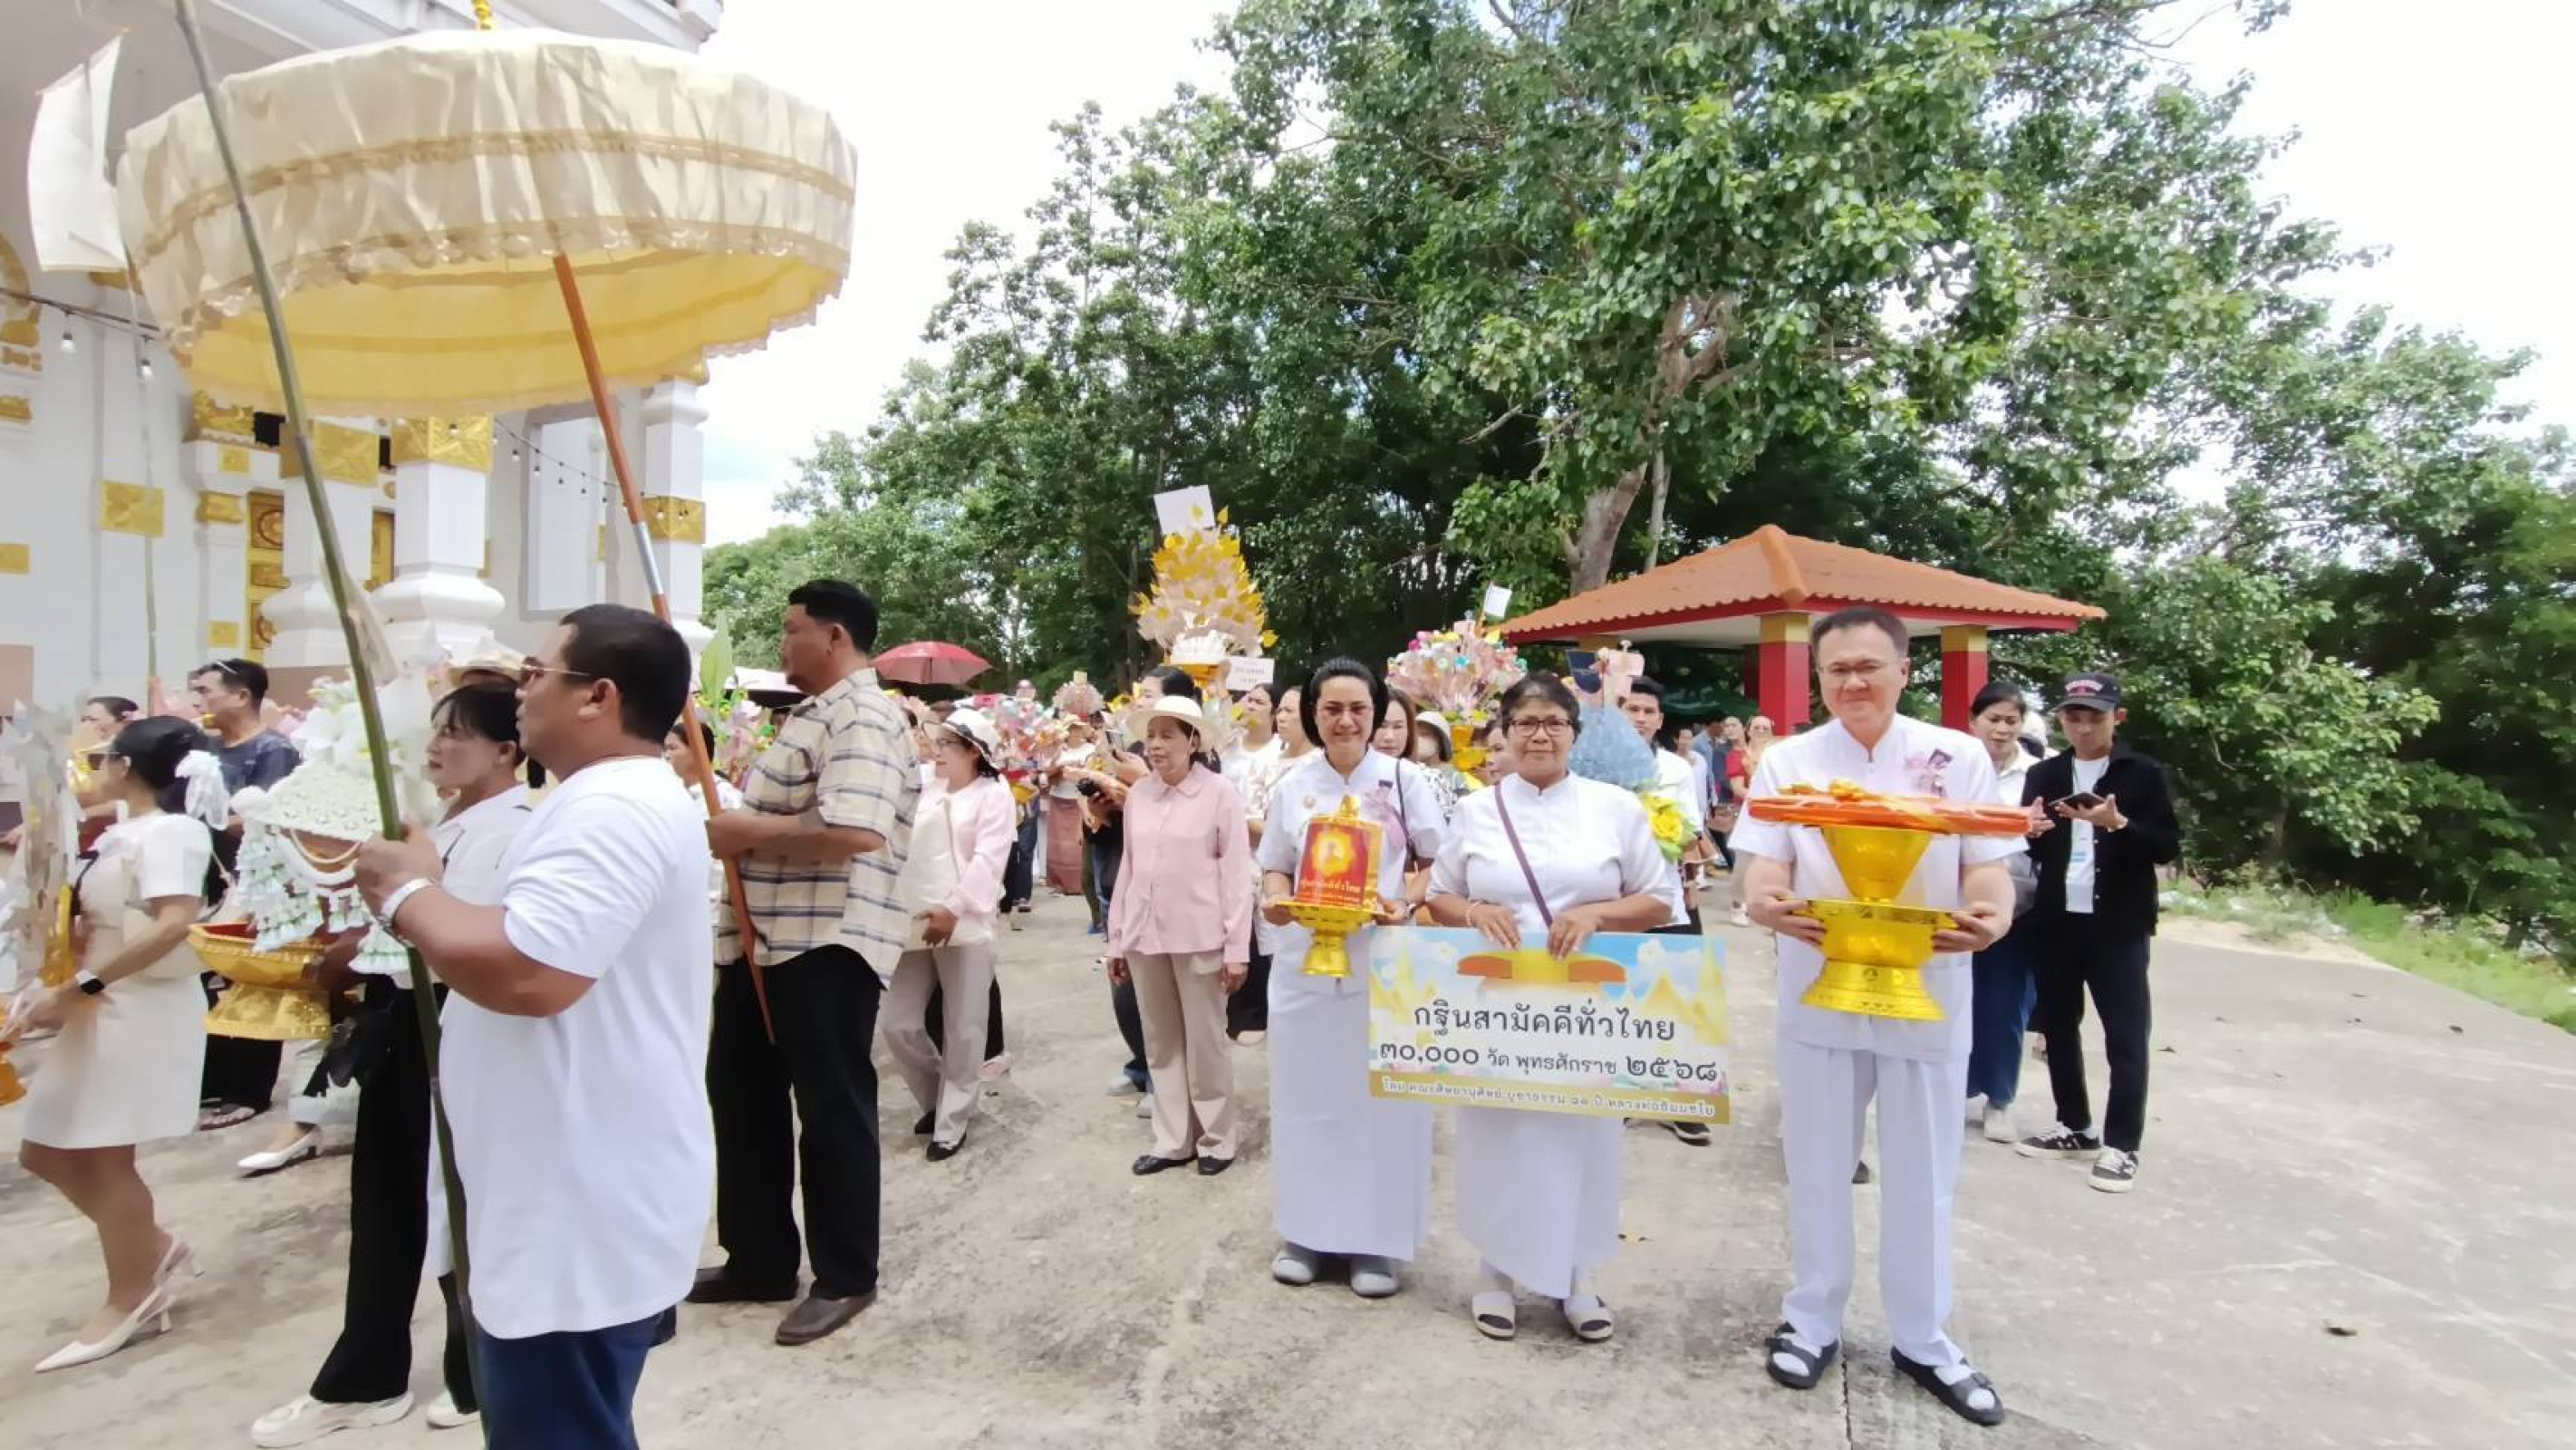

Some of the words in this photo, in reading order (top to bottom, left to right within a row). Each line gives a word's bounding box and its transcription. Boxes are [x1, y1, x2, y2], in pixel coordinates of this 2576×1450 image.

[1414, 998, 1675, 1040] กฐินสามัคคีทั่วไทย
[1380, 1043, 1480, 1065] ๓๐,๐๐๐
[1487, 1047, 1510, 1067] วัด
[1516, 1052, 1616, 1076] พุทธศักราช
[1626, 1056, 1717, 1081] ๒๕๖๘
